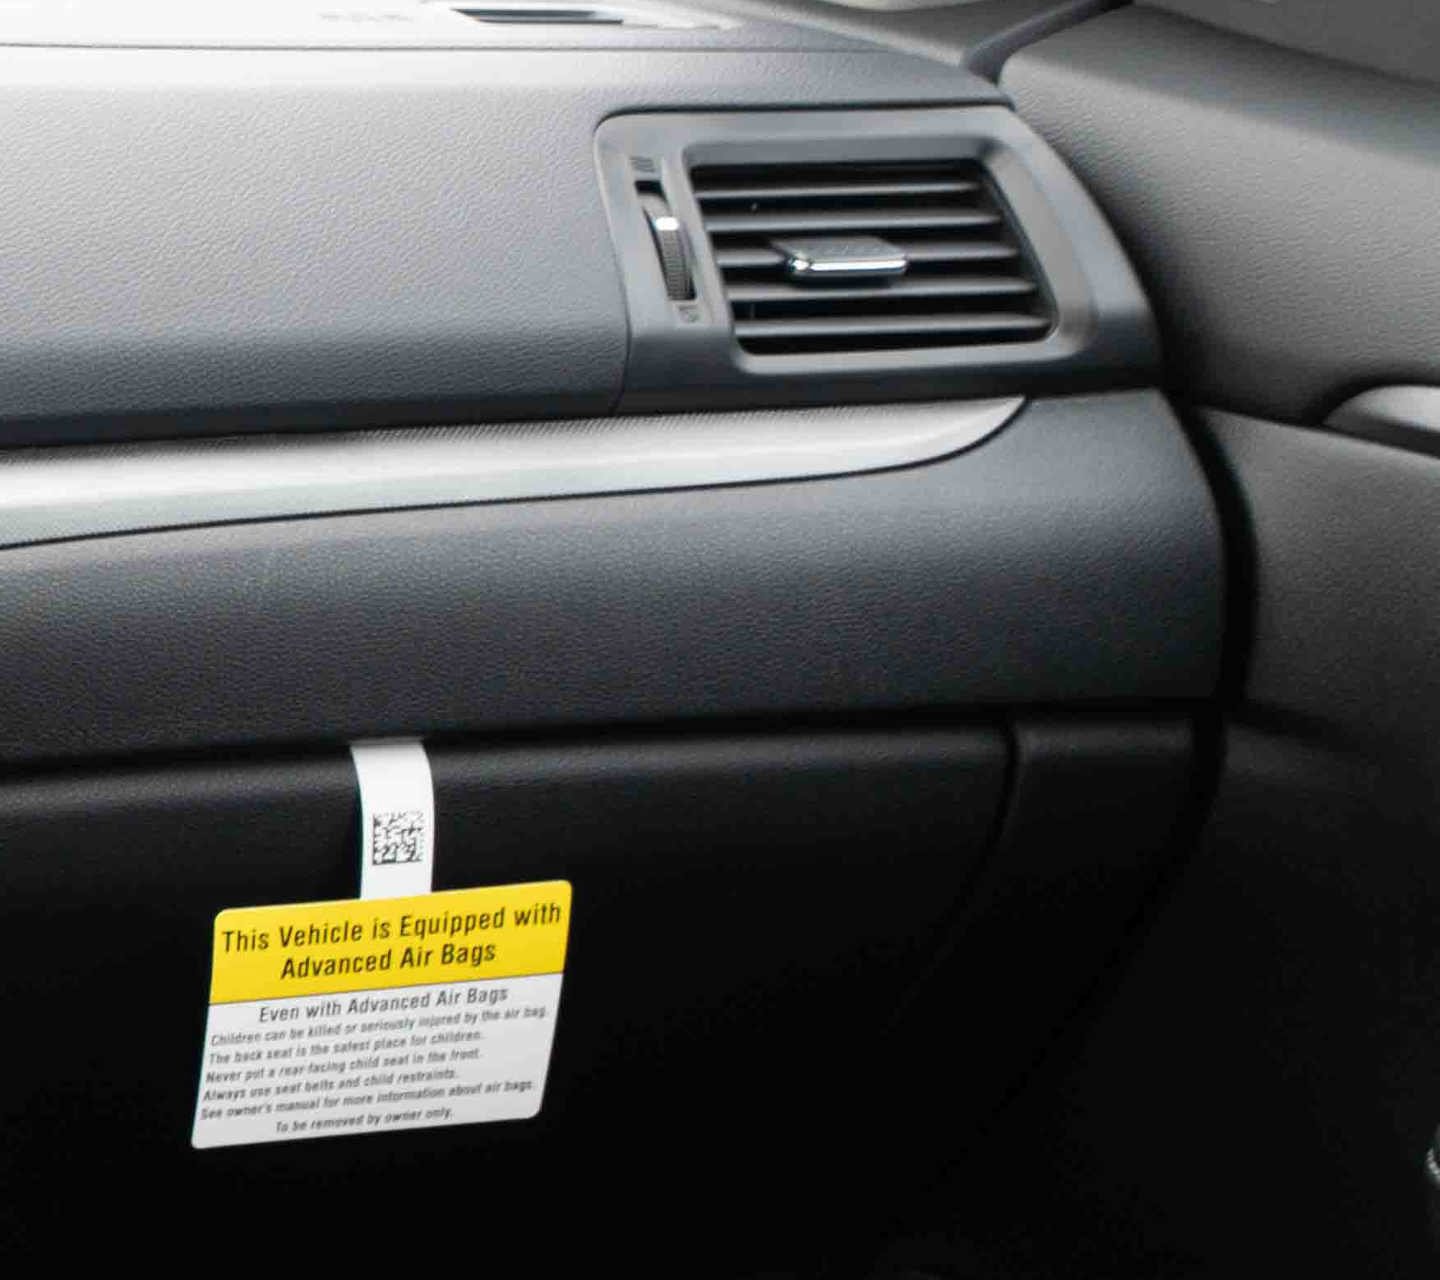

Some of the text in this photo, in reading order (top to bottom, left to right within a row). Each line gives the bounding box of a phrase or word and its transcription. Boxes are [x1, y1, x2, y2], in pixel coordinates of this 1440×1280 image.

[221, 902, 562, 953] This Vehicle is Equipped with
[280, 941, 497, 980] Advanced Air Bags
[259, 987, 509, 1023] Even with Advanced Air Bags
[211, 1033, 262, 1047] Children
[265, 1030, 286, 1042] can
[289, 1027, 305, 1040] be
[307, 1022, 342, 1037] killed
[344, 1022, 357, 1033] or
[360, 1018, 416, 1032] seriously
[418, 1013, 461, 1028] injured
[464, 1011, 479, 1024] by
[481, 1008, 500, 1021] the
[504, 1007, 521, 1019] air
[205, 1070, 241, 1083] Never
[244, 1068, 265, 1082] put
[349, 1055, 380, 1070] child
[382, 1053, 410, 1066] seat
[412, 1052, 424, 1064] in
[427, 1049, 447, 1062] the
[209, 1052, 230, 1065] The
[234, 1049, 262, 1063] back
[266, 1047, 293, 1060] seat
[296, 1045, 307, 1057] is
[310, 1042, 330, 1055] the
[333, 1038, 371, 1053] safest
[373, 1035, 407, 1051] place
[409, 1033, 427, 1047] for
[200, 1107, 223, 1121] See
[226, 1103, 272, 1118] owner's
[275, 1096, 320, 1112] manual
[323, 1094, 340, 1108] for
[342, 1093, 373, 1105] more
[376, 1086, 446, 1103] information
[448, 1082, 483, 1096] about
[485, 1081, 502, 1094] air
[203, 1087, 247, 1102] Always
[249, 1085, 272, 1097] use
[275, 1082, 301, 1096] seat
[304, 1078, 334, 1093] belts
[338, 1075, 361, 1090] and
[363, 1073, 394, 1087] child
[275, 1120, 290, 1133] To
[292, 1119, 308, 1132] be
[310, 1115, 365, 1129] removed
[367, 1112, 382, 1126] by
[385, 1109, 422, 1122] owner
